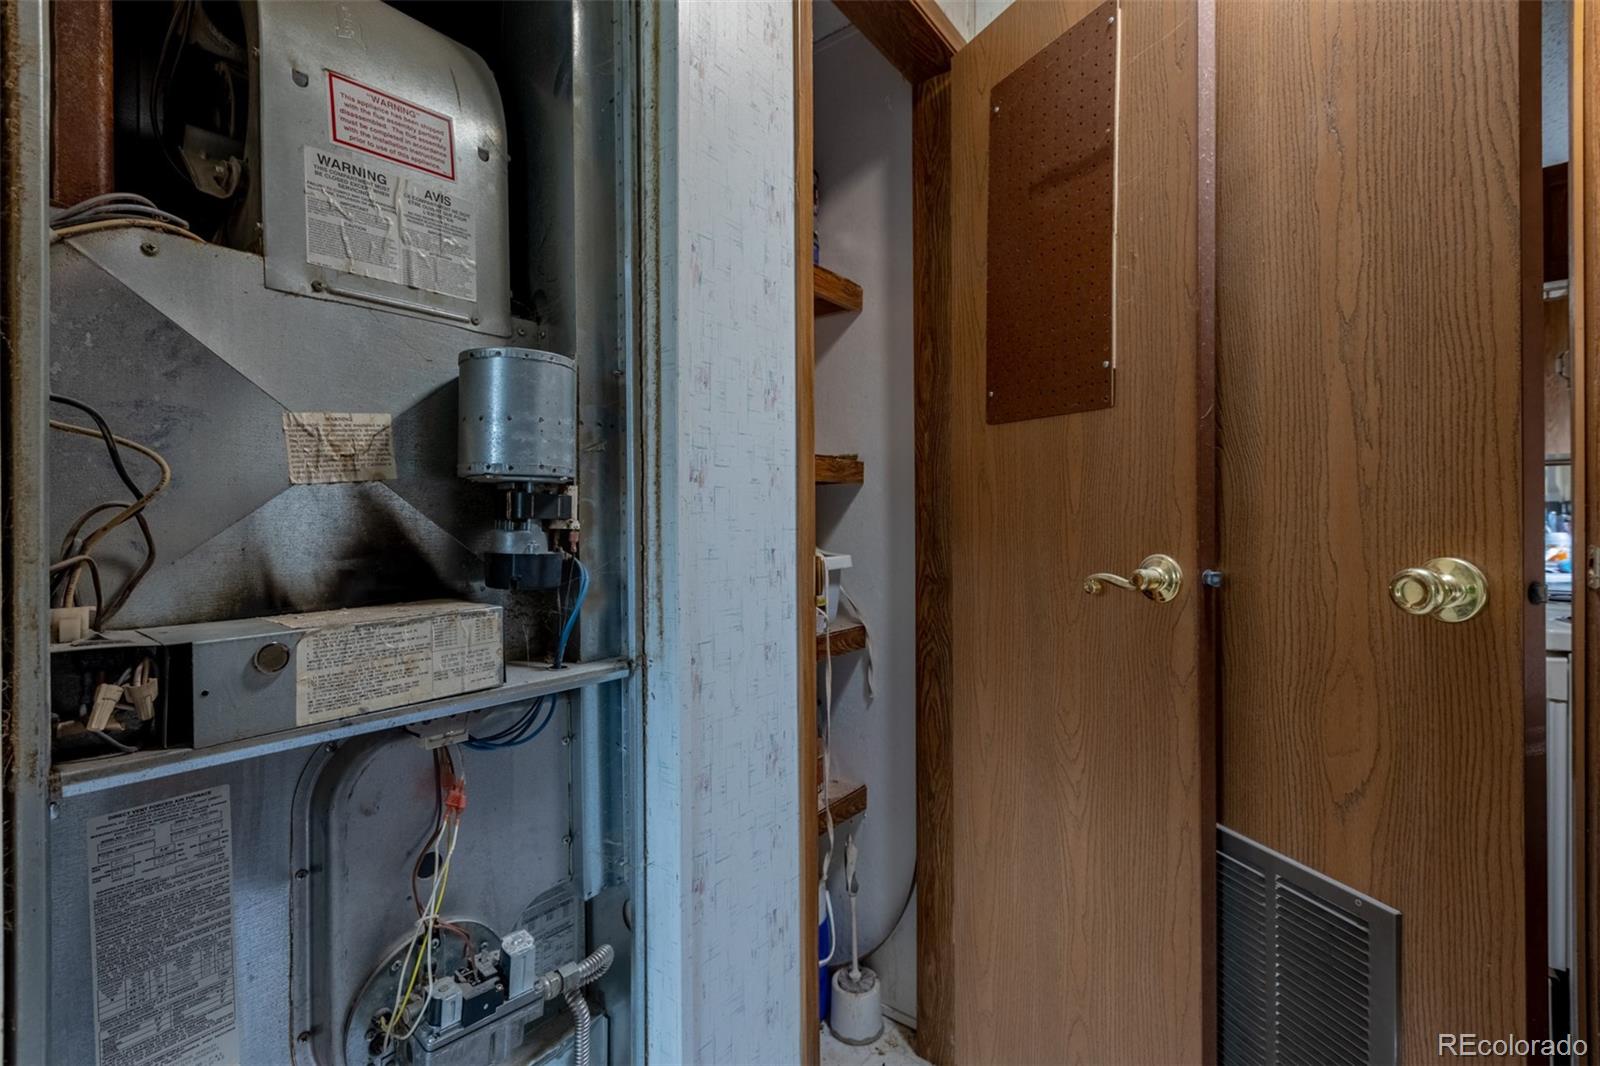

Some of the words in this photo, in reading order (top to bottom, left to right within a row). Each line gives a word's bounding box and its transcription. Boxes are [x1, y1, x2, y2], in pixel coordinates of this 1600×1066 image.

[340, 93, 354, 102] This
[357, 99, 388, 116] appliance
[390, 111, 401, 120] has
[403, 117, 418, 126] been
[420, 123, 444, 136] shipped
[344, 102, 358, 111] with
[360, 107, 370, 116] the
[372, 112, 384, 121] flue
[386, 118, 416, 133] assembly
[418, 129, 441, 143] partially
[340, 117, 357, 126] must
[359, 122, 367, 130] be
[369, 127, 402, 143] completed
[412, 142, 446, 158] accordance
[343, 125, 358, 134] with
[360, 130, 370, 138] the
[372, 135, 408, 151] installation
[409, 148, 445, 164] instructions
[349, 135, 365, 145] prior
[376, 143, 387, 152] use
[392, 126, 403, 135] The
[418, 137, 446, 151] assembly
[313, 164, 327, 172] THIS
[374, 184, 389, 192] MUST
[317, 154, 386, 183] WARNING
[324, 174, 348, 184] CLOSED
[373, 189, 389, 197] WHEN
[424, 190, 451, 206] AVIS
